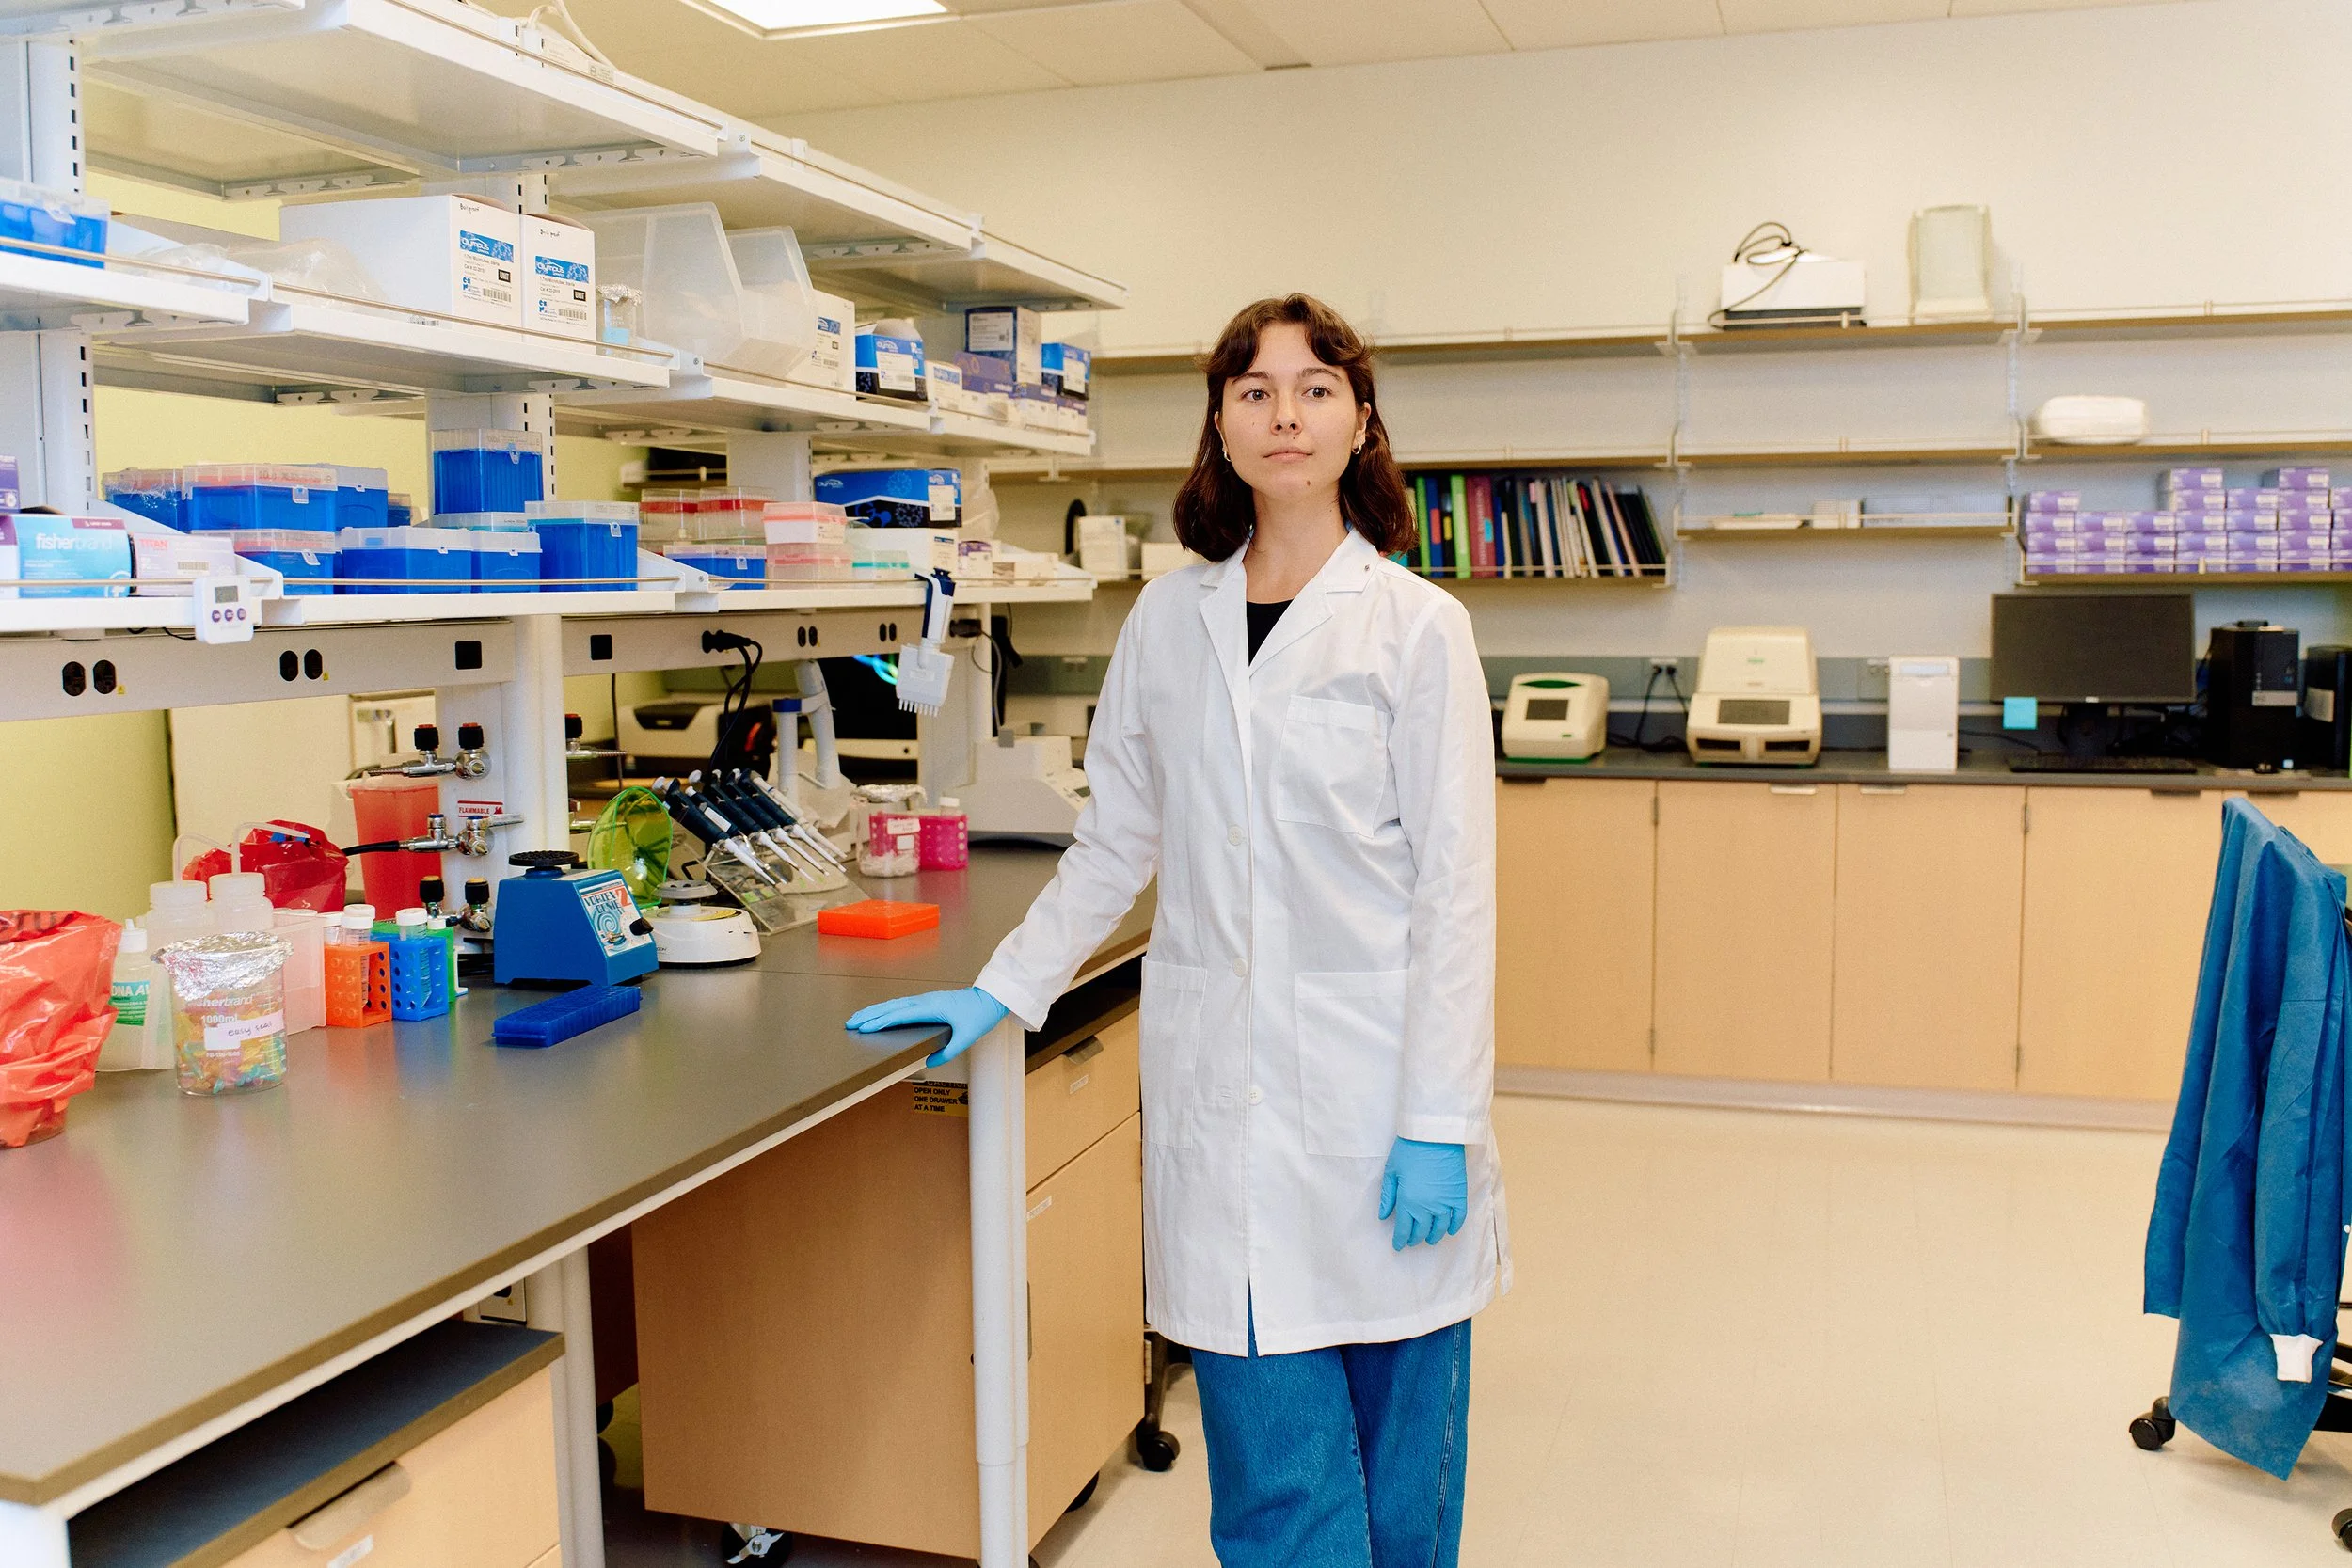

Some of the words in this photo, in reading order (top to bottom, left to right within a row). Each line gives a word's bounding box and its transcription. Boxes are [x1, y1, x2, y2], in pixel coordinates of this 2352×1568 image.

[35, 532, 113, 550] fisherbrand
[139, 538, 168, 549] TITAN
[584, 891, 616, 906] VORTEX
[614, 887, 632, 907] 2
[201, 1013, 238, 1024] 1000ml
[914, 1086, 932, 1095] OPEN
[929, 1097, 958, 1105] DRAWER
[930, 1104, 946, 1113] TIME
